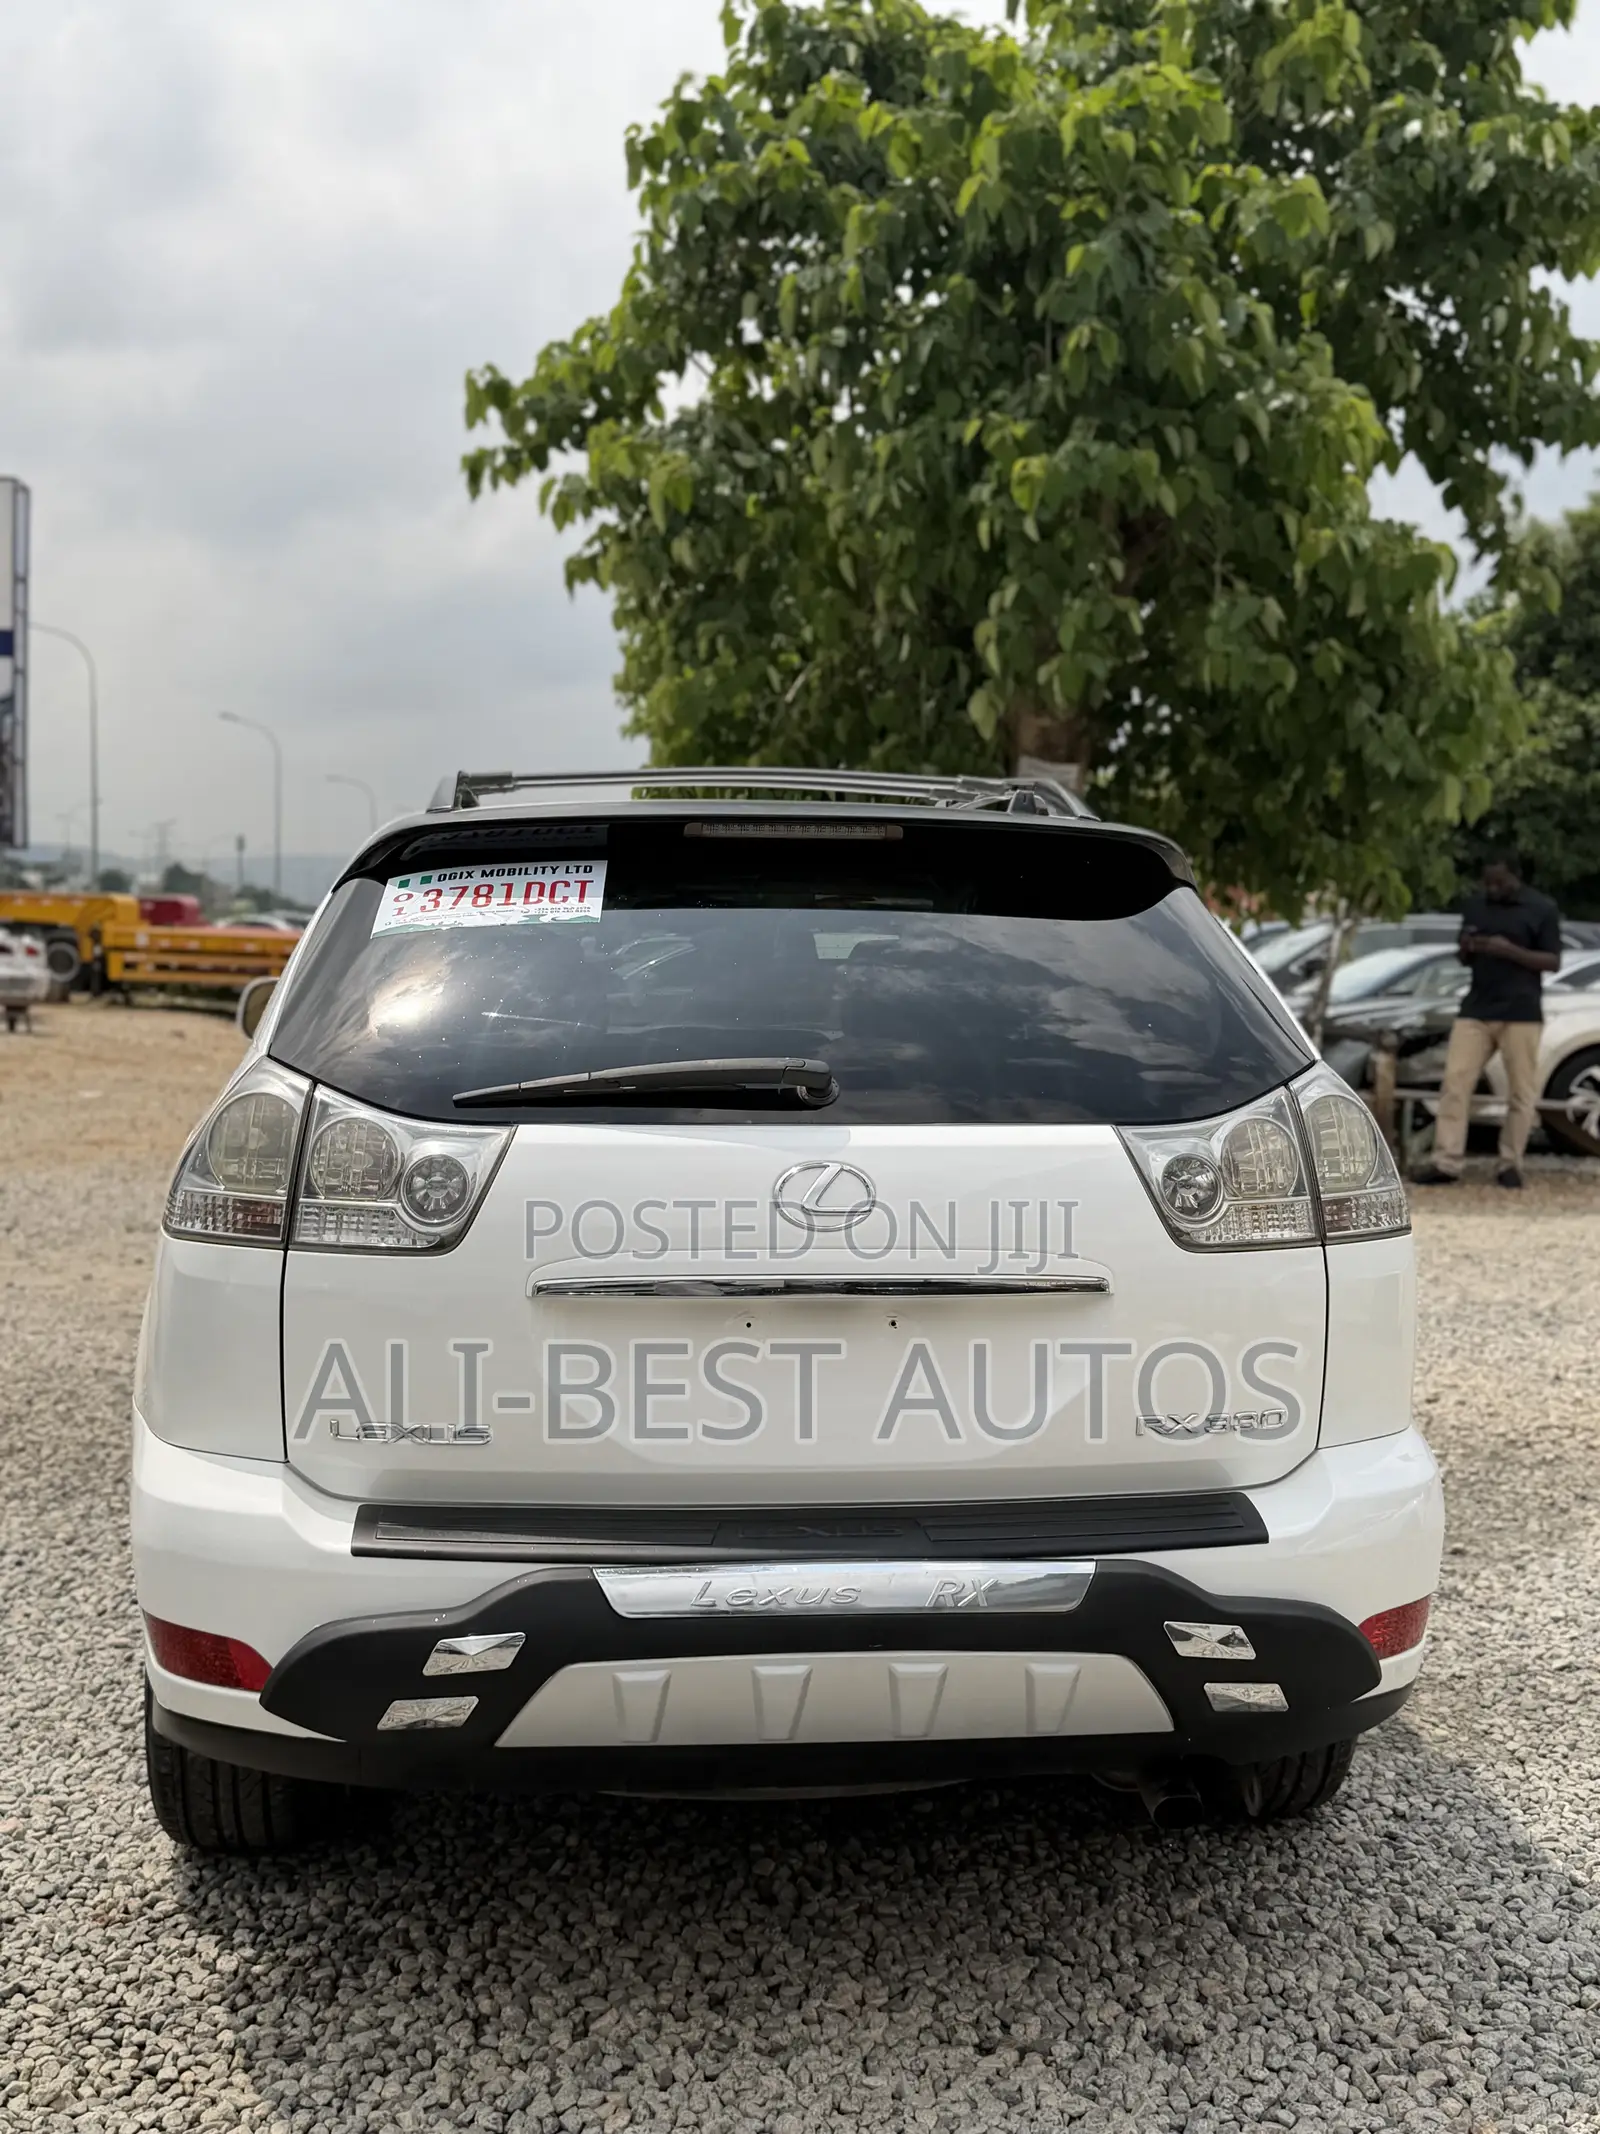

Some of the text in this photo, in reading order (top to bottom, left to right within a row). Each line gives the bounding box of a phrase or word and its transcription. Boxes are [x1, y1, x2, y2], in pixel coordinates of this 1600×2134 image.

[437, 864, 594, 883] OGIX MOBILITY LTD
[419, 880, 595, 913] 3781DCT
[329, 1418, 493, 1446] LEXUS
[690, 1578, 998, 1607] Lexus RX
